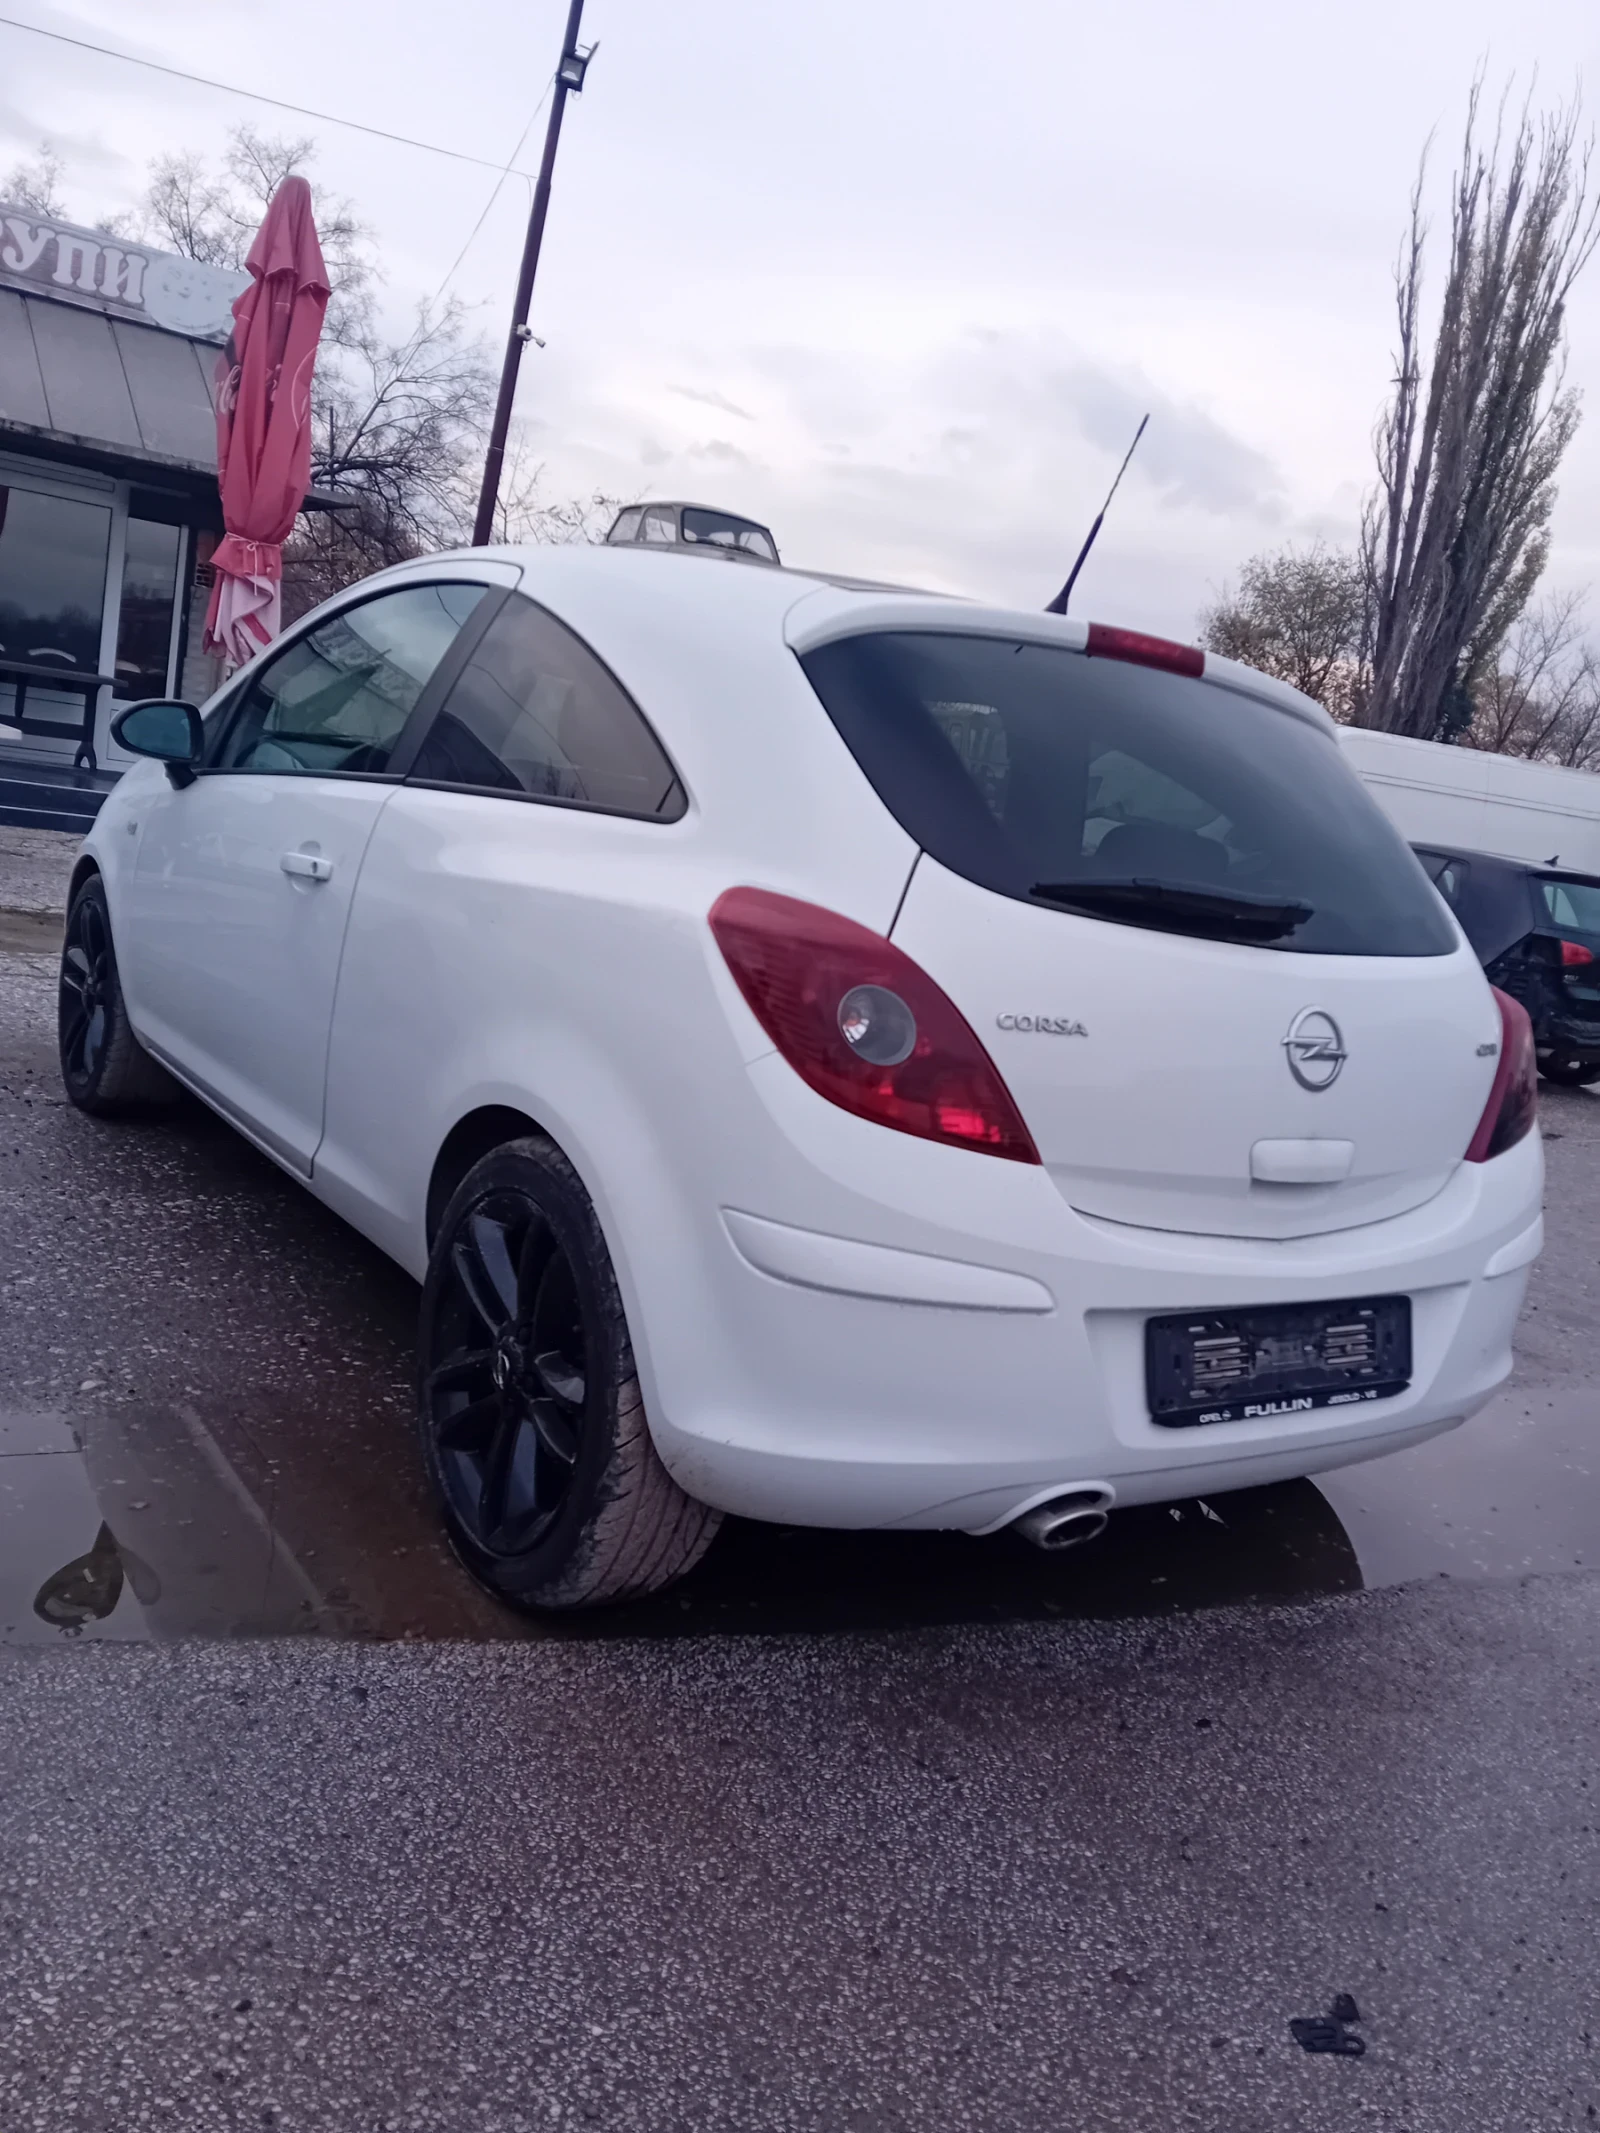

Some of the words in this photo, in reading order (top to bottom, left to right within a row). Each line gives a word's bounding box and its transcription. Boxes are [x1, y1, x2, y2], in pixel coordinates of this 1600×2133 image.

[0, 217, 148, 304] УПИ
[996, 1013, 1089, 1038] CORSA
[1244, 1397, 1312, 1417] FULLIN
